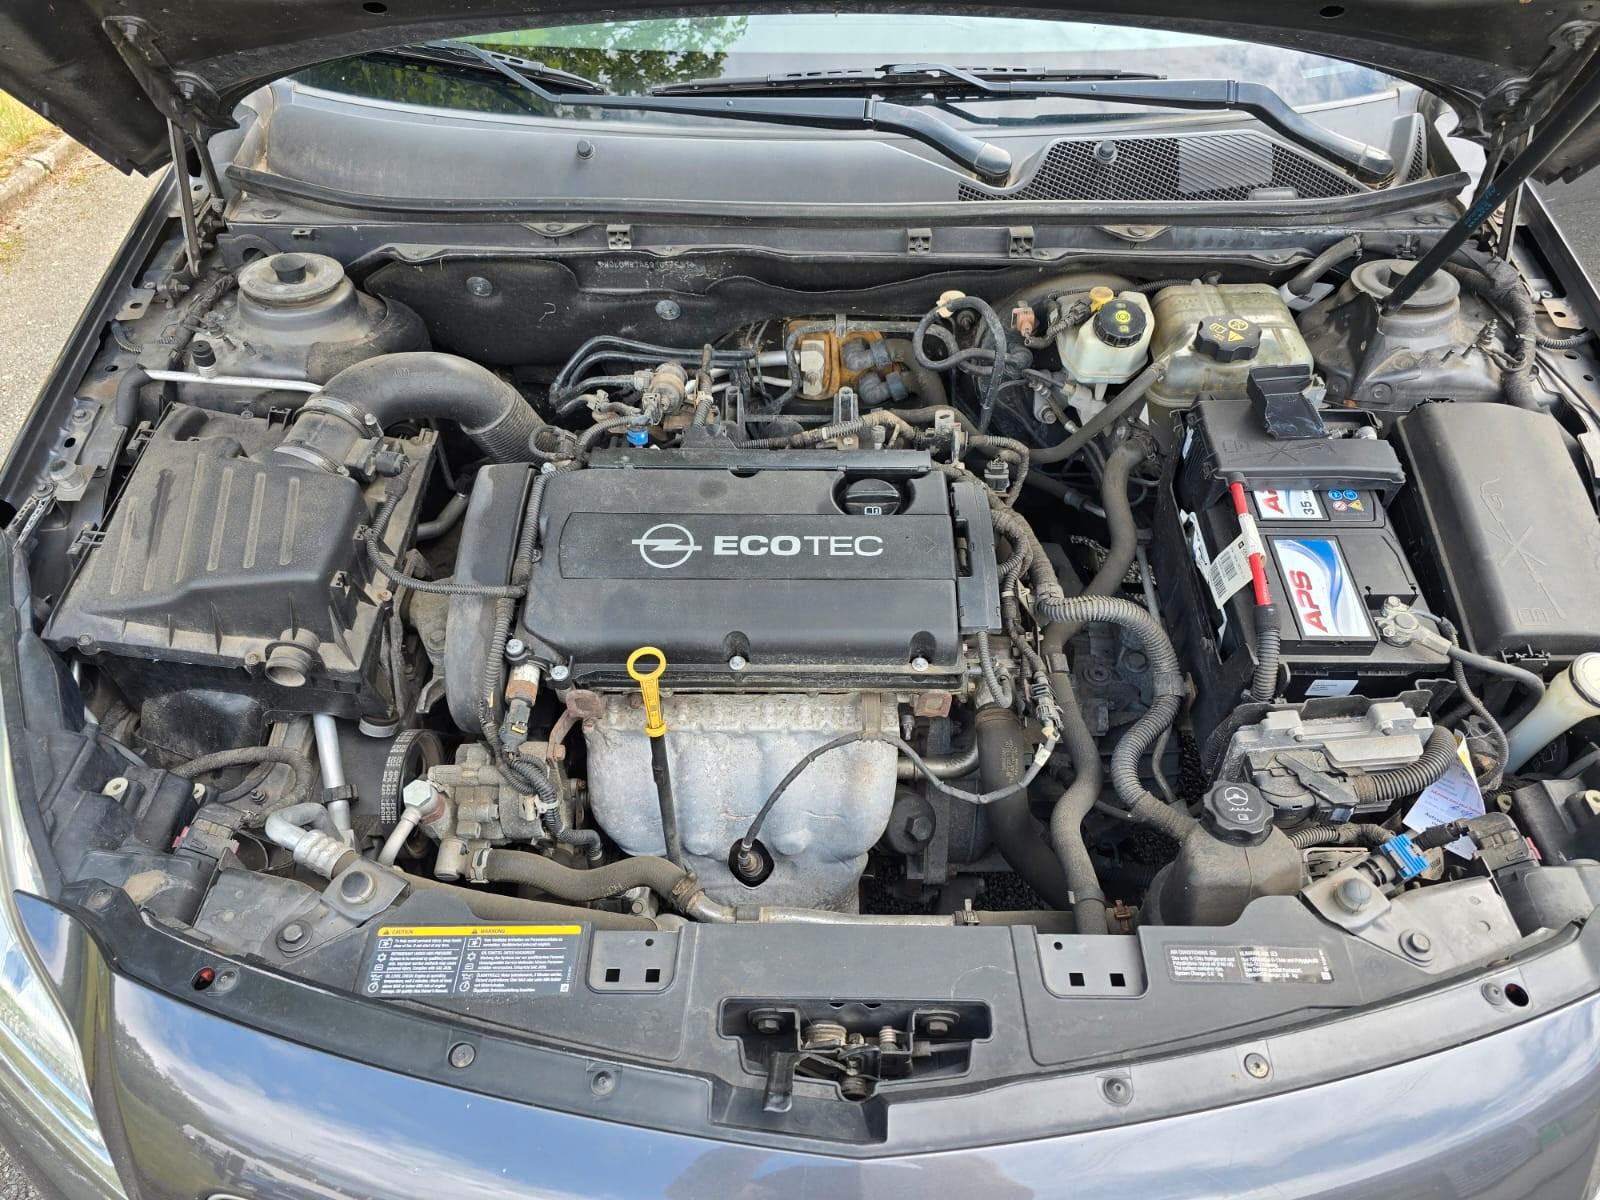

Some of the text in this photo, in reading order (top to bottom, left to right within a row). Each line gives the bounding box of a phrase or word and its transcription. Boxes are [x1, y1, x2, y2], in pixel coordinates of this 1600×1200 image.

[1300, 500, 1315, 515] 35
[713, 535, 884, 557] ECOTEC
[1289, 570, 1328, 633] APS
